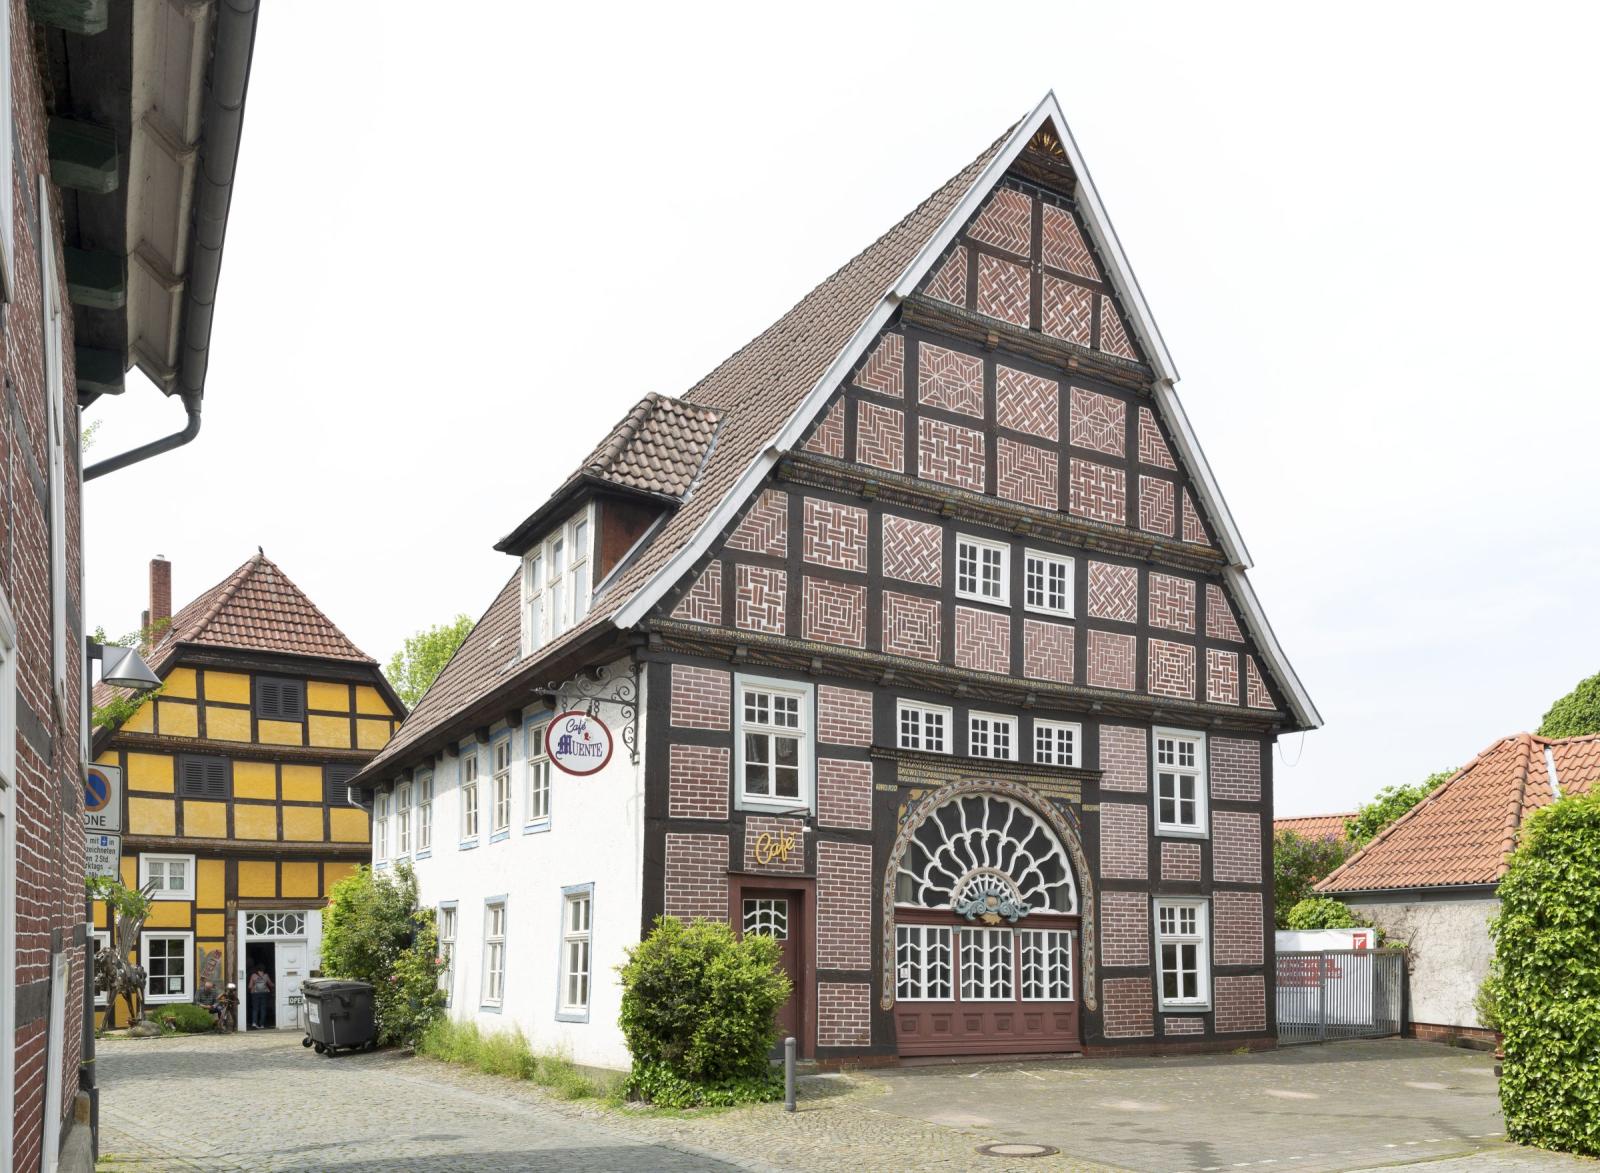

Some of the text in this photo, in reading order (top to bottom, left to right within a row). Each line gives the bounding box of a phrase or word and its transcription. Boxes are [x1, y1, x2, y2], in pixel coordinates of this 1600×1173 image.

[566, 719, 586, 734] Café
[85, 815, 106, 826] ONE
[86, 846, 116, 855] zeichneten
[756, 829, 797, 864] Café
